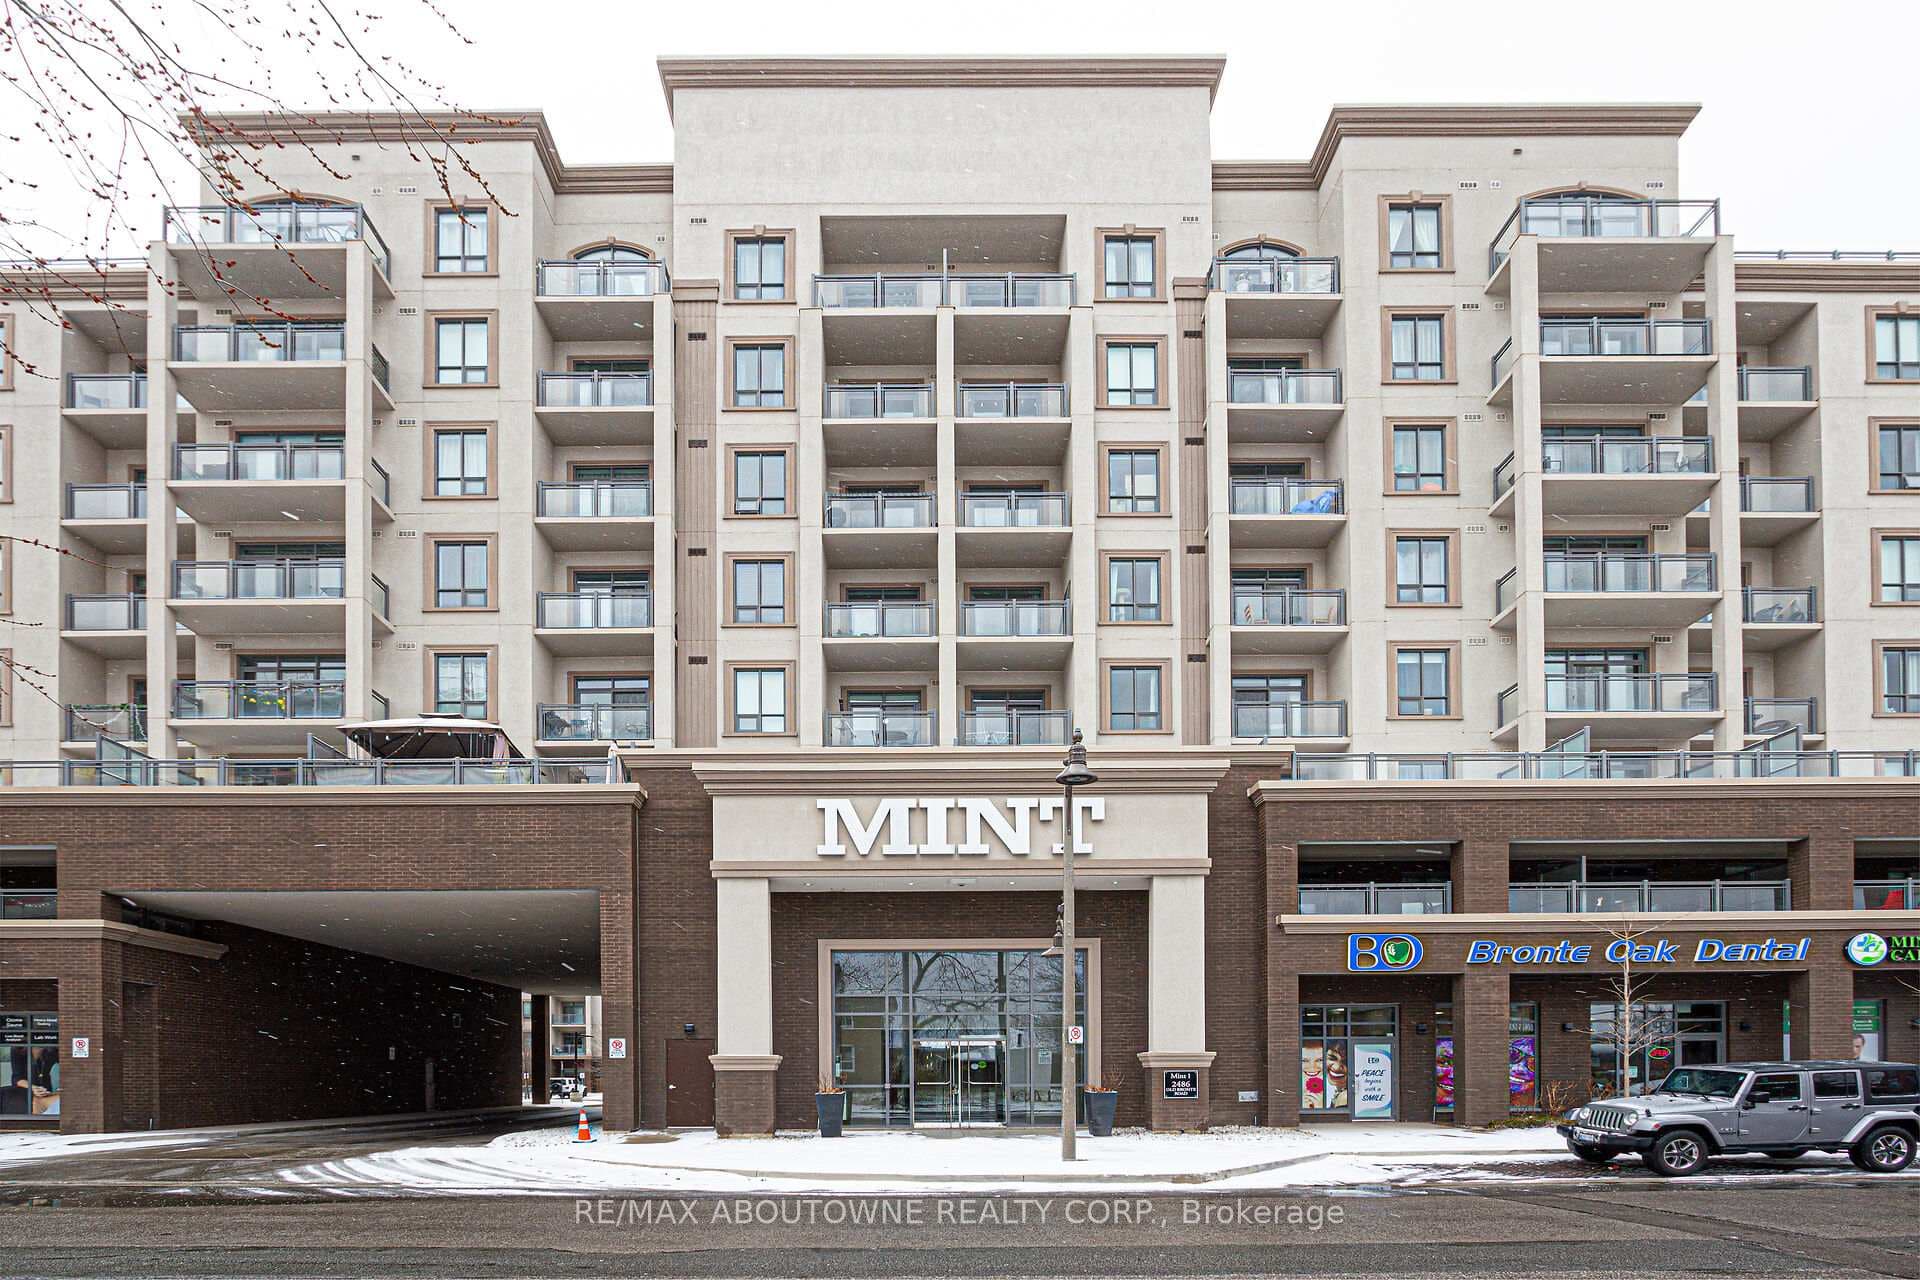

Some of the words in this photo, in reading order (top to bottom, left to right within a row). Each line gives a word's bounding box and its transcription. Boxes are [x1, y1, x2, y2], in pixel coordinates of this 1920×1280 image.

[816, 797, 1105, 856] MINT
[1466, 940, 1591, 964] Bronte
[1605, 938, 1680, 963] Oak
[1694, 937, 1812, 962] Dental
[1890, 949, 1920, 961] CA
